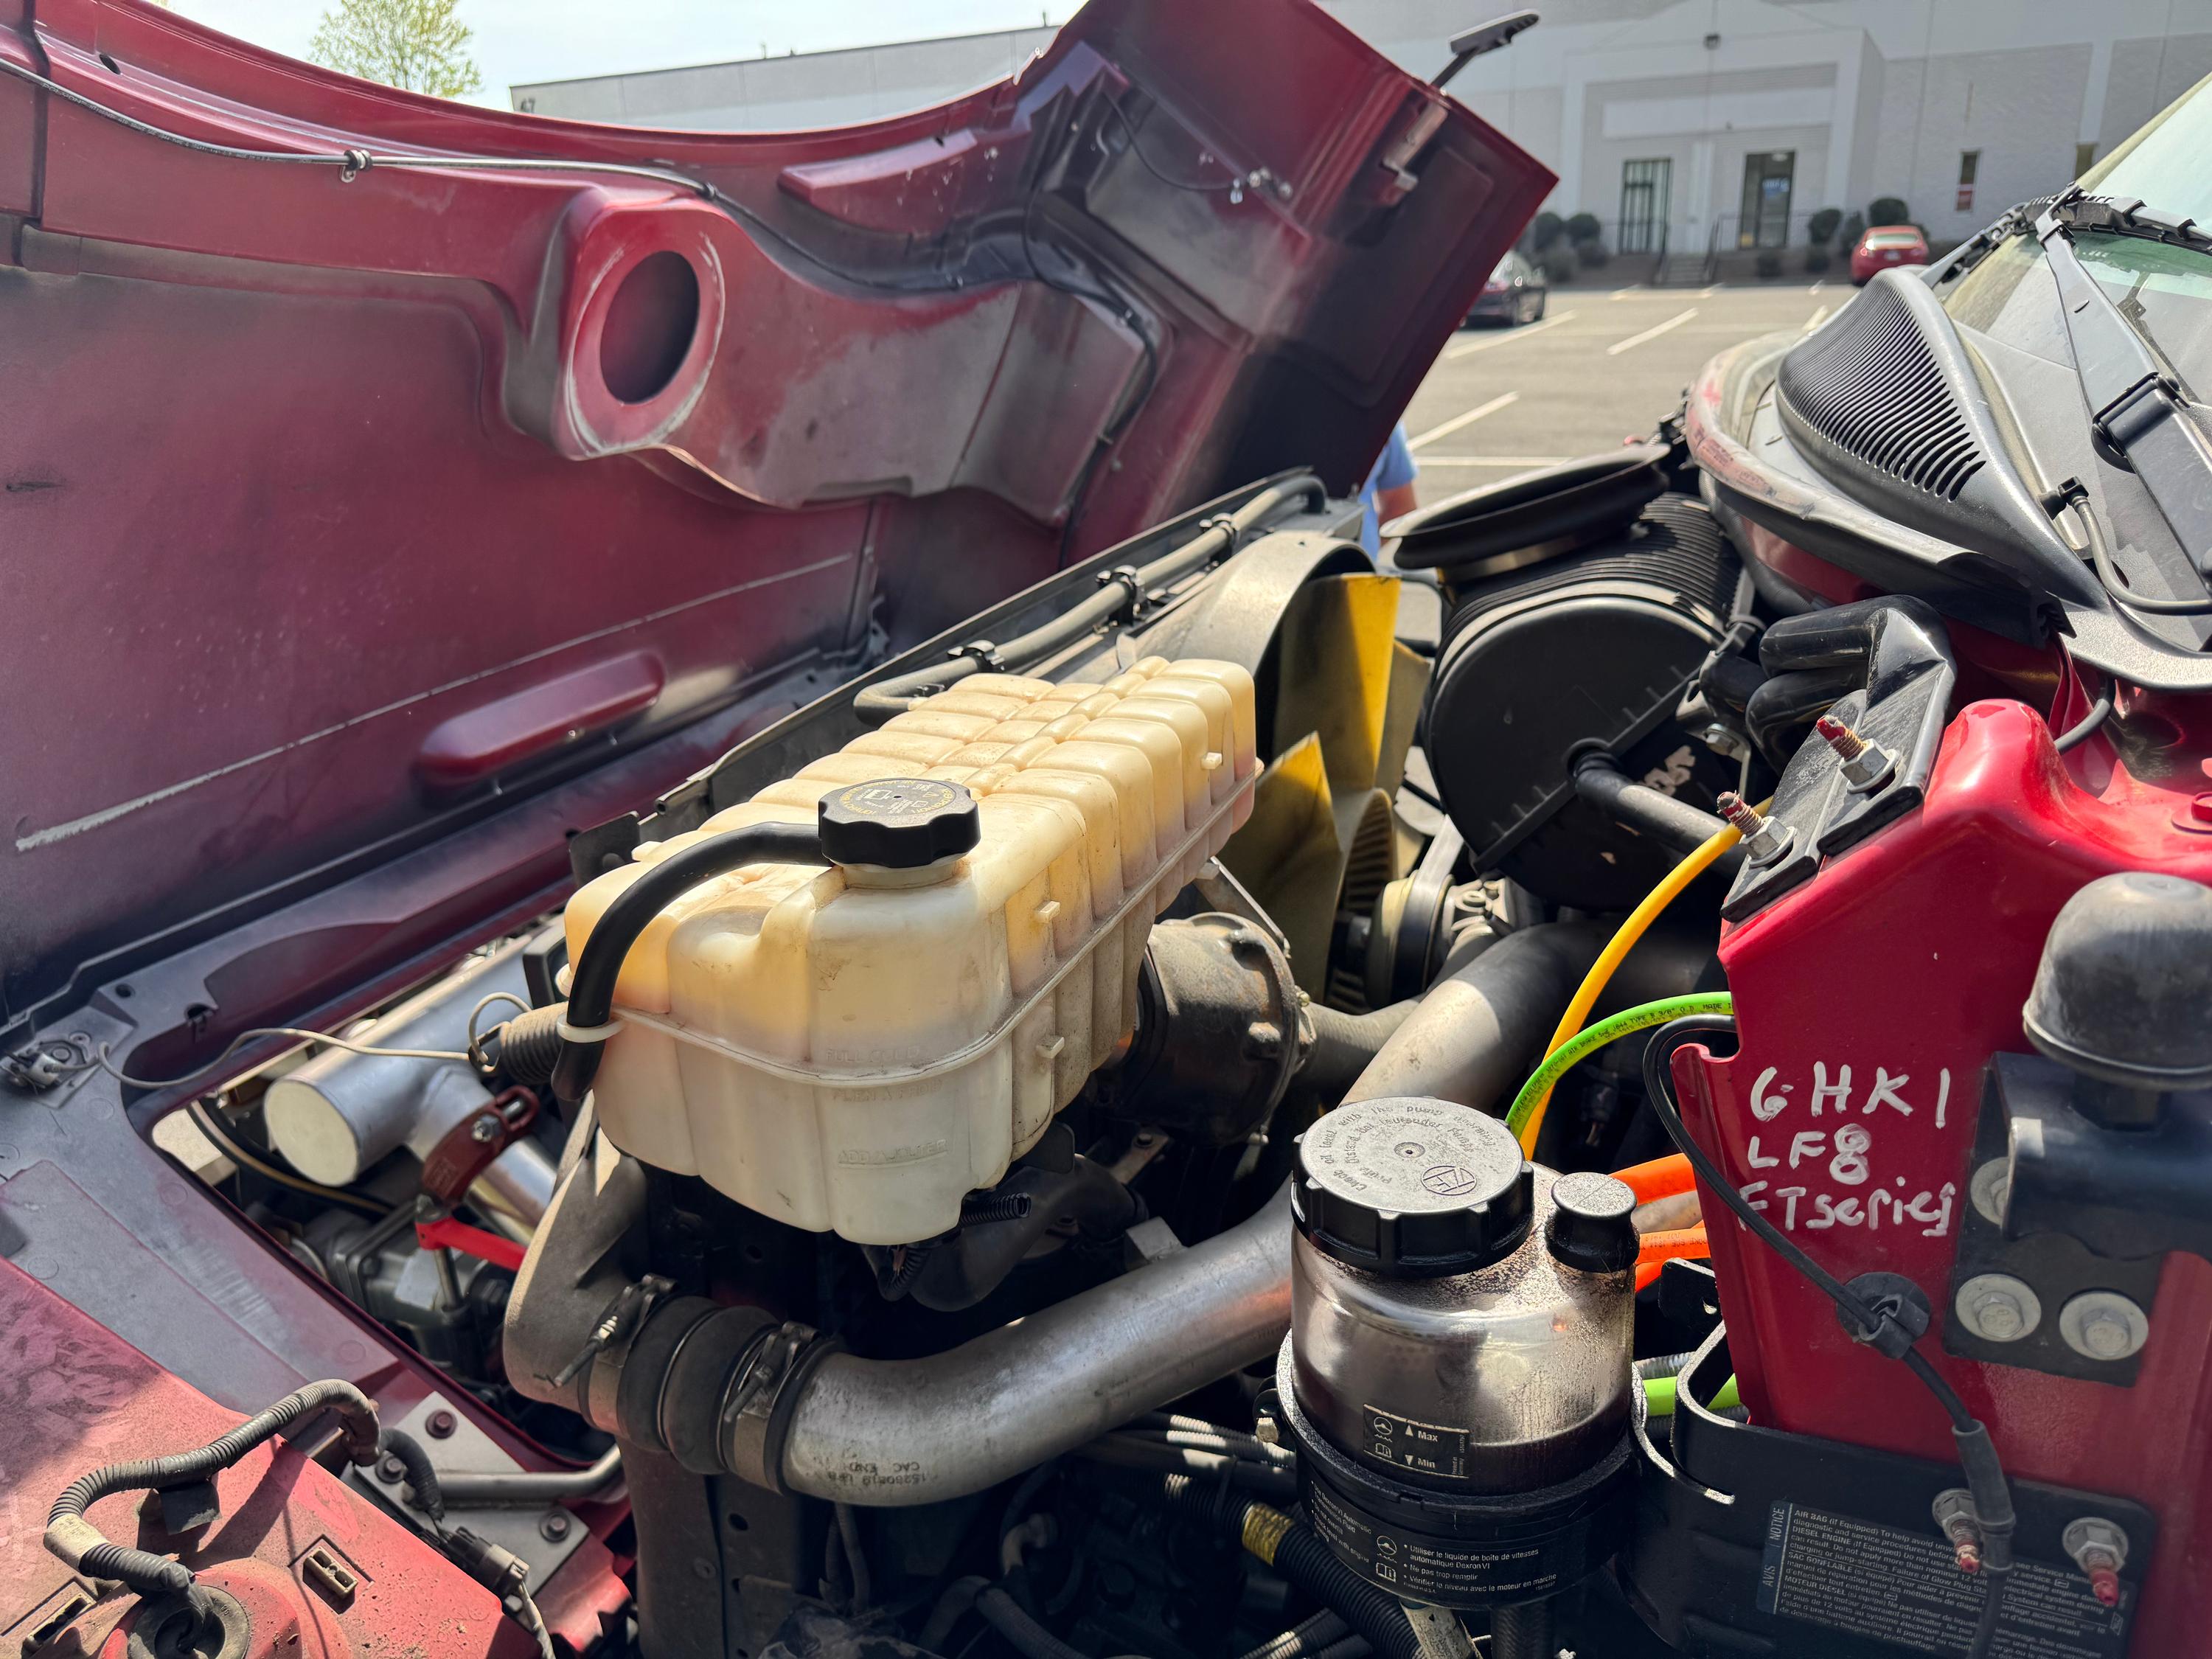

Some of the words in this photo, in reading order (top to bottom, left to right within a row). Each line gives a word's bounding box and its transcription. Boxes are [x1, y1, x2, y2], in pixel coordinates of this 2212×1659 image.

[1630, 1015, 1646, 1023] TYPE
[1338, 1113, 1363, 1126] with
[1747, 1123, 1871, 1185] LF8
[1418, 1430, 1438, 1442] Max
[892, 1461, 919, 1471] CAC
[1418, 1458, 1436, 1469] Min
[1343, 1512, 1371, 1534] Automatic
[1343, 1519, 1356, 1533] Fluid
[1770, 1507, 1784, 1540] NOTICE
[1327, 1527, 1338, 1541] level
[1339, 1538, 1350, 1551] with
[1350, 1548, 1369, 1563] engine
[1792, 1517, 1833, 1533] diagnostic
[1834, 1527, 1849, 1537] and
[1851, 1531, 1879, 1544] service
[1881, 1538, 1927, 1556] procedures
[1928, 1550, 1952, 1561] before
[1794, 1509, 1809, 1518] AIR
[1810, 1512, 1828, 1523] BAG
[1839, 1520, 1879, 1536] Equipped)
[1879, 1529, 1891, 1537] To
[1891, 1531, 1910, 1543] help
[1911, 1537, 1933, 1548] avoid
[2033, 1565, 2064, 1578] Service
[1410, 1545, 1435, 1556] Utiliser
[1444, 1552, 1469, 1561] liquide
[1512, 1549, 1539, 1559] vitesses
[1410, 1554, 1454, 1568] automatique
[1792, 1525, 1820, 1538] DIESEL
[1821, 1531, 1851, 1545] ENGINE
[1863, 1542, 1902, 1558] Equipped)
[1903, 1551, 1913, 1560] Do
[1916, 1555, 1929, 1563] not
[2051, 1587, 2079, 1600] engine
[1410, 1564, 1419, 1573] Ne
[1436, 1571, 1450, 1579] trop
[1410, 1575, 1434, 1587] Vérifier
[1497, 1582, 1521, 1591] moteur
[1533, 1573, 1557, 1585] marche
[1762, 1565, 1775, 1587] AVIS
[1787, 1551, 1804, 1561] SAC
[1806, 1556, 1852, 1573] GONFLABLE
[1896, 1577, 1915, 1587] Pour
[1916, 1582, 1938, 1593] aider
[1789, 1541, 1823, 1556] charging
[1891, 1565, 1919, 1578] Failure
[1921, 1572, 1929, 1580] of
[1930, 1574, 1952, 1585] Glow
[1952, 1579, 1971, 1591] Plug
[2007, 1593, 2038, 1607] System
[2040, 1601, 2056, 1610] can
[1790, 1534, 1805, 1543] can
[1832, 1543, 1843, 1552] Do
[1846, 1546, 1858, 1555] not
[1860, 1549, 1882, 1561] apply
[1883, 1556, 1904, 1566] more
[1906, 1561, 1924, 1571] than
[1925, 1565, 1958, 1579] nominal
[1961, 1573, 1972, 1582] 12
[2045, 1594, 2075, 1607] system
[2076, 1601, 2104, 1615] during
[1828, 1577, 1843, 1587] tout
[1784, 1575, 1817, 1588] MOTEUR
[1887, 1600, 1898, 1608] Ne
[1899, 1604, 1913, 1613] pas
[1914, 1607, 1941, 1619] utiliser
[1942, 1613, 1952, 1622] de
[1787, 1559, 1815, 1572] manuel
[1816, 1566, 1826, 1575] de
[1869, 1580, 1888, 1590] pour
[1890, 1585, 1901, 1593] les
[1944, 1597, 1954, 1605] de
[2056, 1625, 2080, 1637] avant
[1792, 1593, 1809, 1604] plus
[1811, 1598, 1820, 1606] de
[1823, 1601, 1832, 1609] 12
[1834, 1604, 1853, 1613] volts
[1833, 1596, 1860, 1607] moteur
[1861, 1603, 1899, 1618] pourraient
[1946, 1623, 1957, 1631] Ne
[1958, 1627, 1972, 1635] pas
[1935, 1637, 1947, 1645] en
